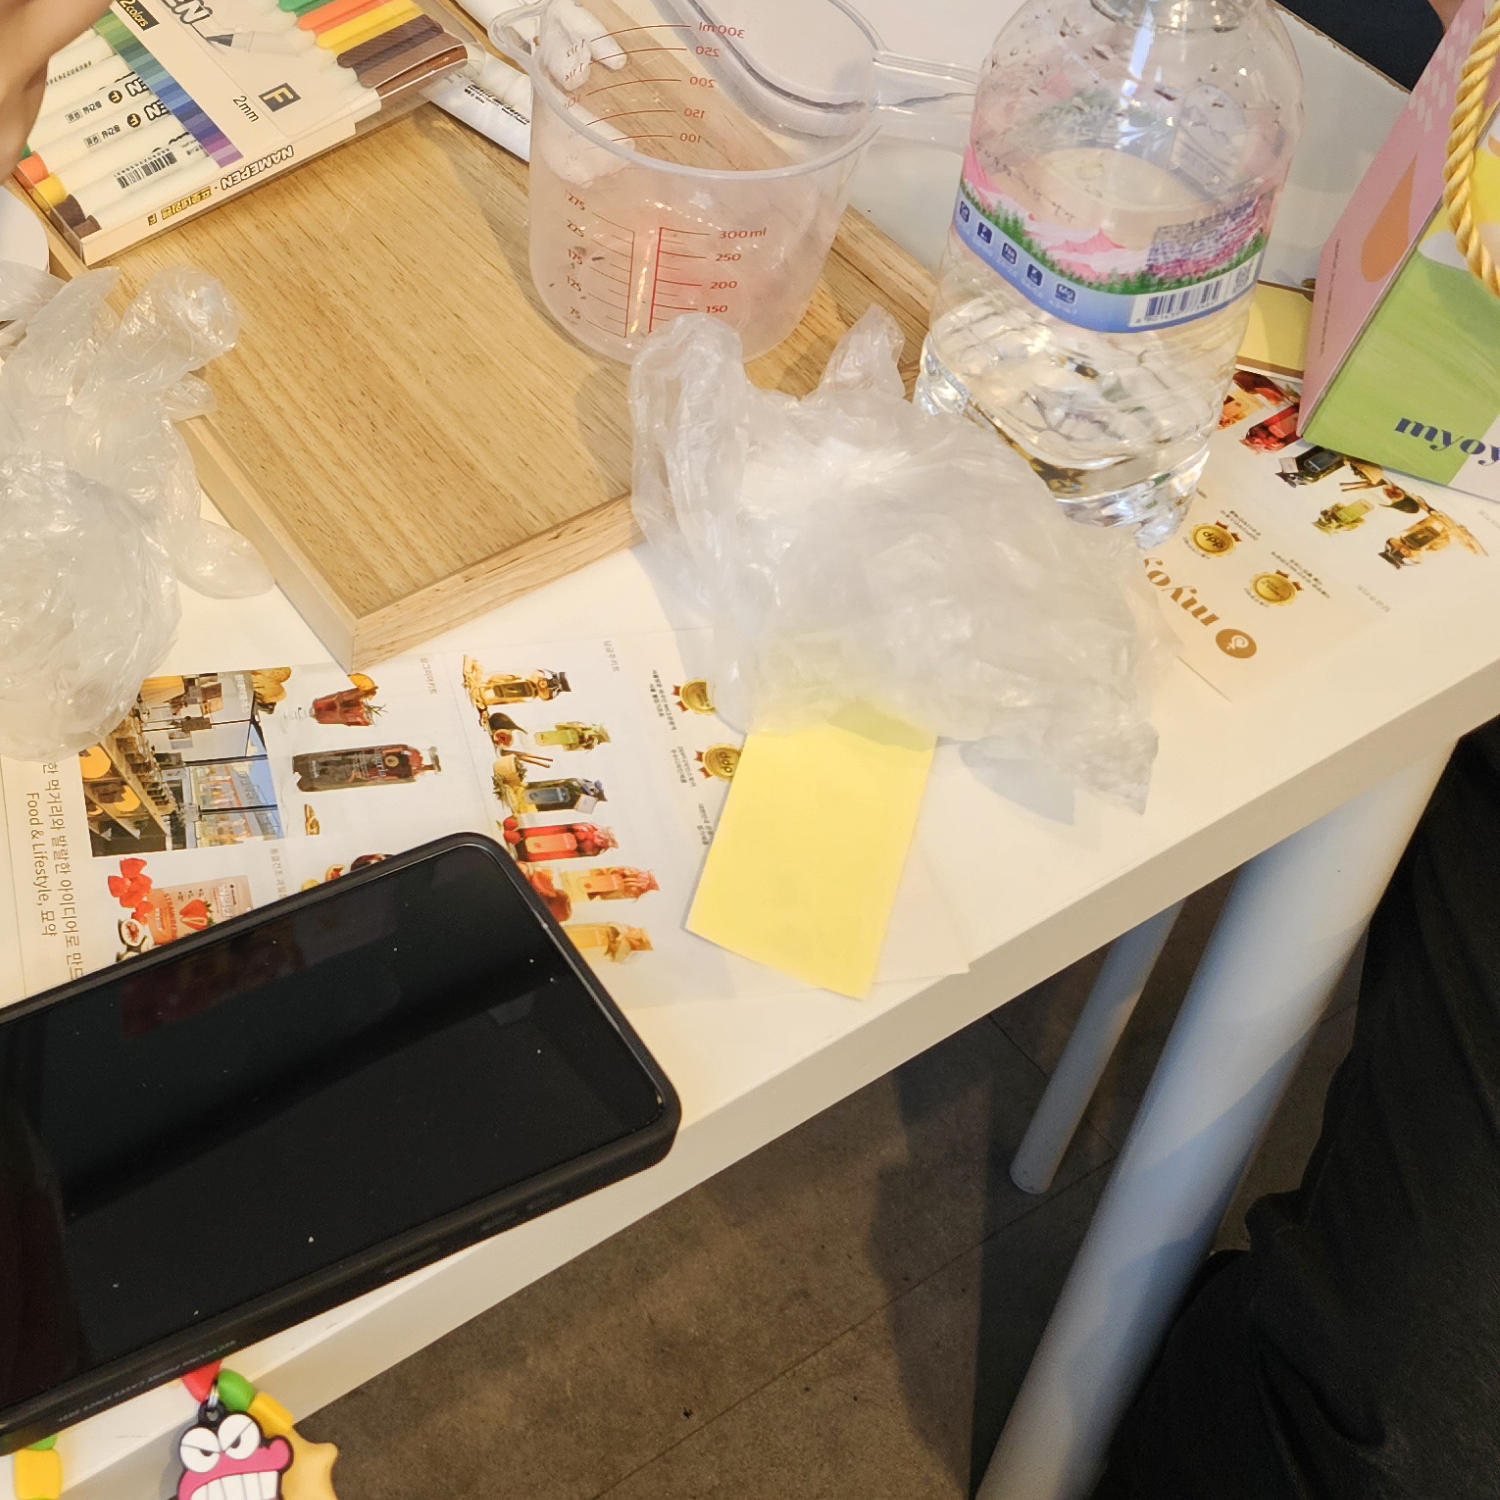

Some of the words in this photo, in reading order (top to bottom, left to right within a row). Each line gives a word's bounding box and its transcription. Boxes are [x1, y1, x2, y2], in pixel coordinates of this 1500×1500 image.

[232, 95, 260, 125] 2mm
[219, 145, 294, 191] NAMEPEN
[719, 227, 767, 240] 300ml
[715, 251, 742, 263] 250
[710, 280, 738, 291] 200
[705, 303, 729, 315] 150
[1202, 530, 1226, 549] ddp
[718, 750, 734, 774] ddp
[25, 791, 43, 826] Food
[43, 778, 66, 831] 먹거리와
[30, 828, 44, 839] &
[50, 834, 72, 875] 발랄한
[27, 841, 54, 906] Lifestyle,
[38, 908, 57, 938] 묘약
[55, 878, 81, 948] 아이디어로
